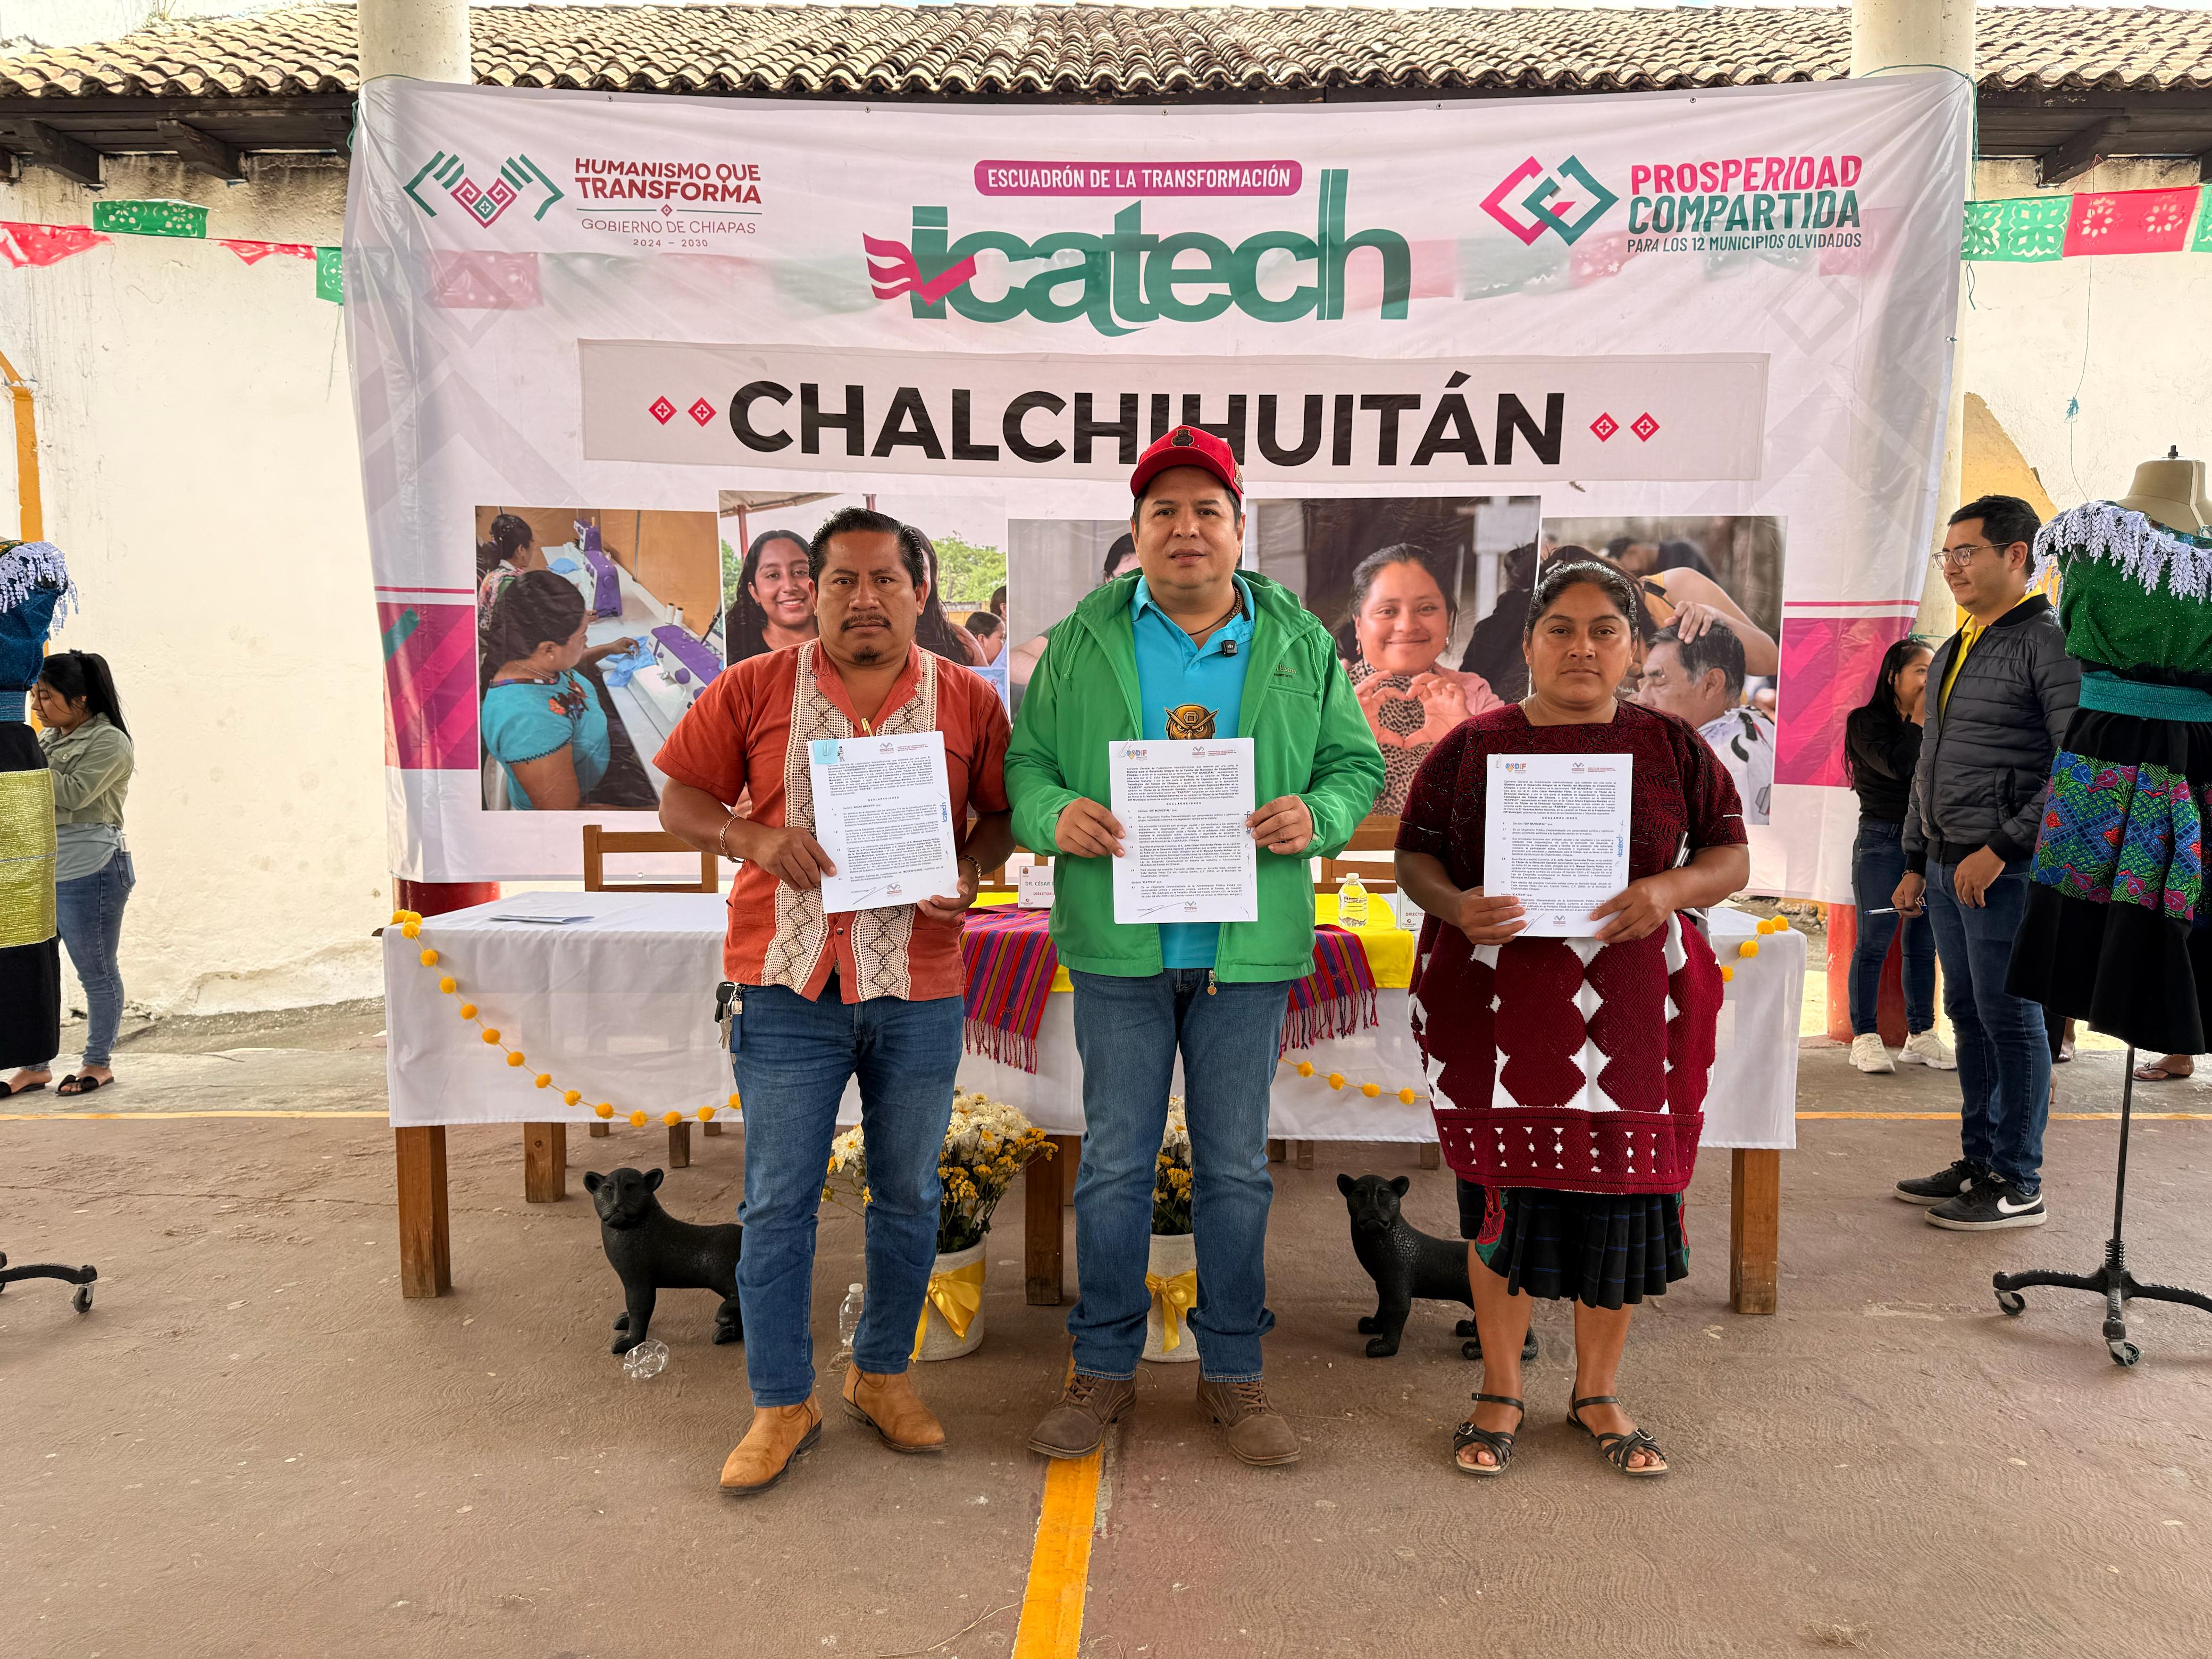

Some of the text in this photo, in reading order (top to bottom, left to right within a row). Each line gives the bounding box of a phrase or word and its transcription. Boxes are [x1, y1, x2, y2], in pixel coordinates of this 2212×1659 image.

[575, 158, 761, 182] HUMANISMO QUE
[988, 165, 1291, 188] ESCUADRÓN DE LA TRANSFORMACIÓN
[1631, 155, 1862, 195] PROSPERIDAD
[575, 177, 762, 205] TRANSFORMA
[1628, 190, 1861, 234] COMPARTIDA
[581, 219, 756, 234] GOBIERNO DE CHIAPAS
[633, 239, 661, 247] 2024
[681, 239, 708, 247] 2030
[912, 169, 1411, 337] icatech
[1627, 233, 1862, 253] PARA LOS 12 MUNICIPIOS OLVIDADOS
[730, 370, 1564, 465] CHALCHIHUITÁN
